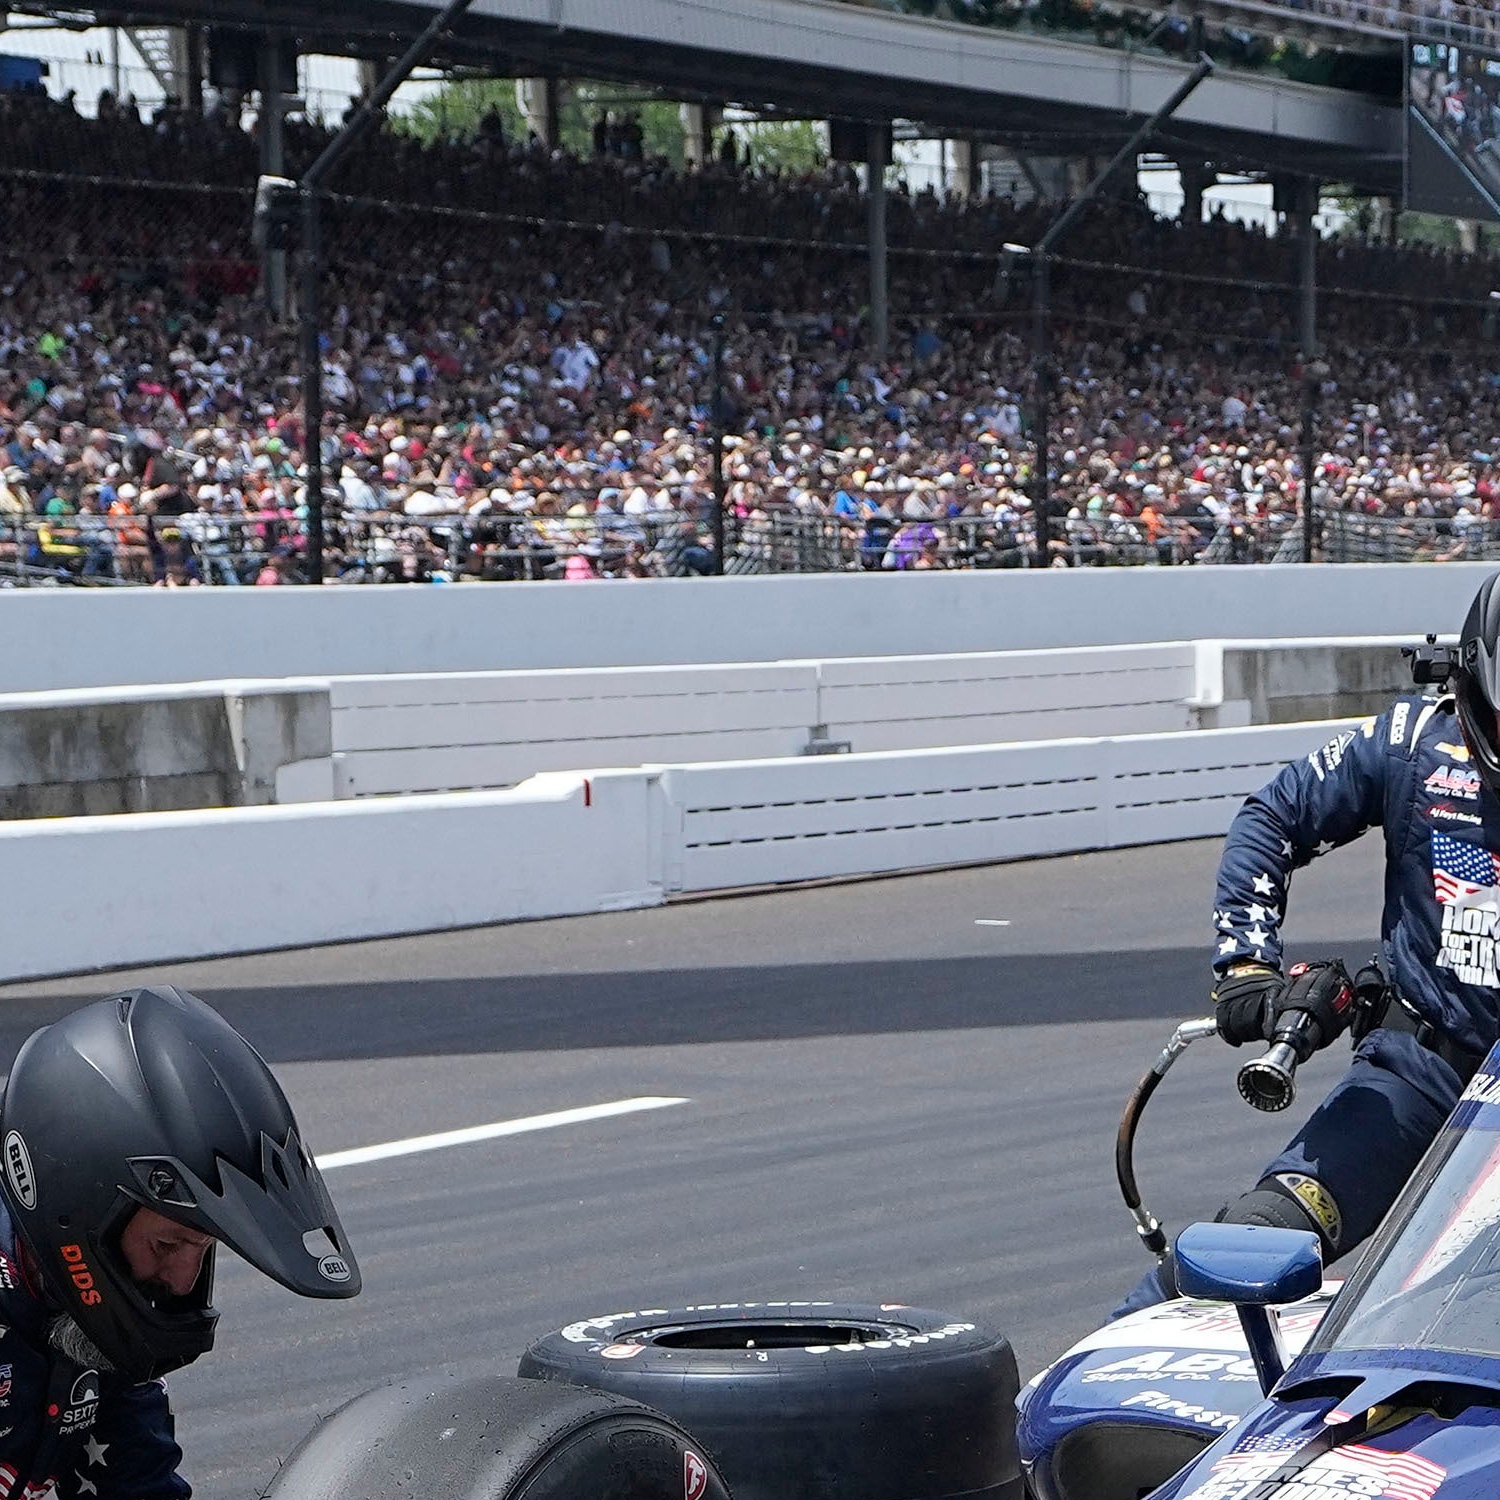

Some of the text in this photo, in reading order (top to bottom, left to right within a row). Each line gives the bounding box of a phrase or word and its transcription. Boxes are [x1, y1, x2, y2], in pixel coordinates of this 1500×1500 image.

[1423, 765, 1483, 793] ABC
[8, 1143, 32, 1201] BELL
[60, 1244, 102, 1306] DIDS
[323, 1260, 348, 1275] BELL
